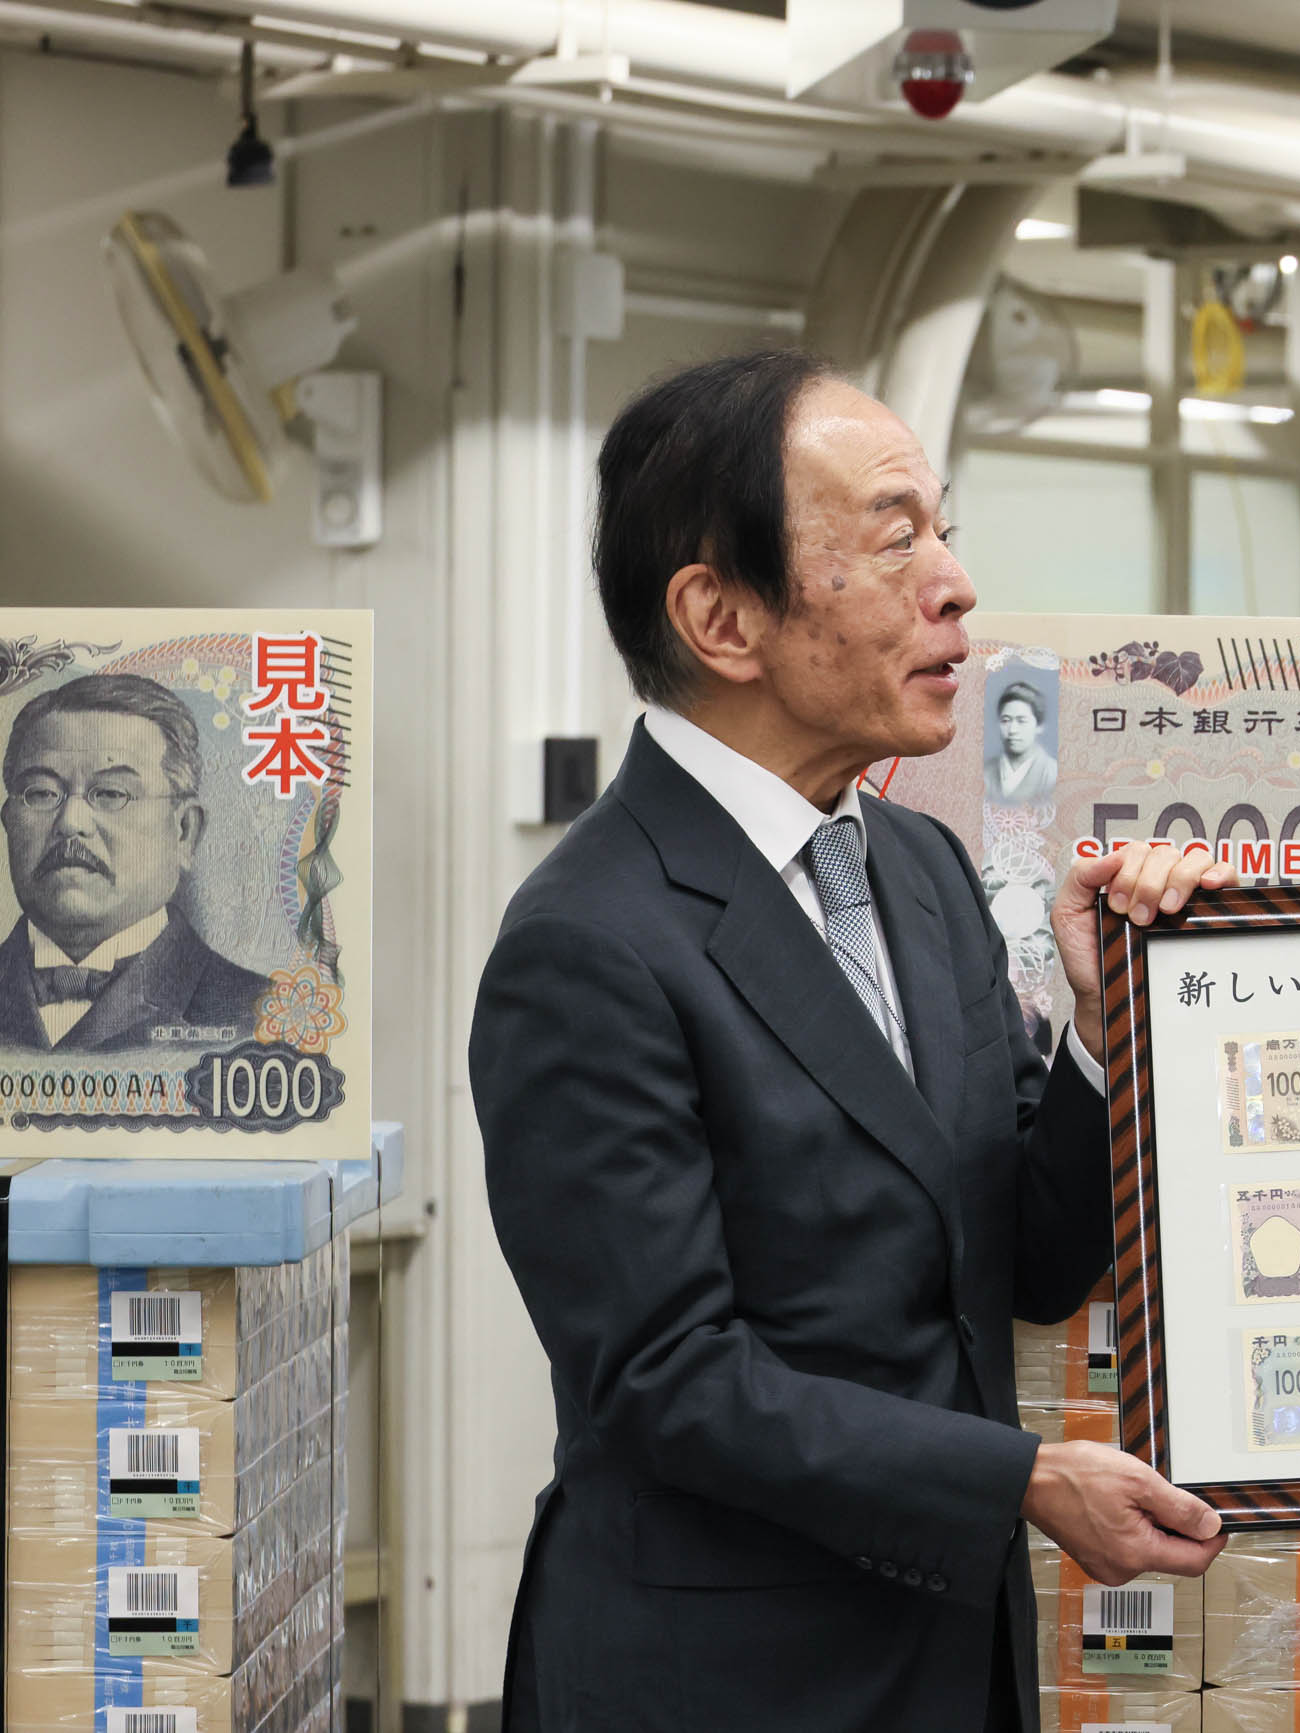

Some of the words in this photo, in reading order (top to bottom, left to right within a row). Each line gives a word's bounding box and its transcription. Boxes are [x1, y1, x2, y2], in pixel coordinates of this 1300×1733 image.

[248, 635, 325, 794] 見本
[212, 1057, 321, 1118] 1000
[1236, 1188, 1283, 1202] 五千円
[1252, 1335, 1287, 1347] 千円
